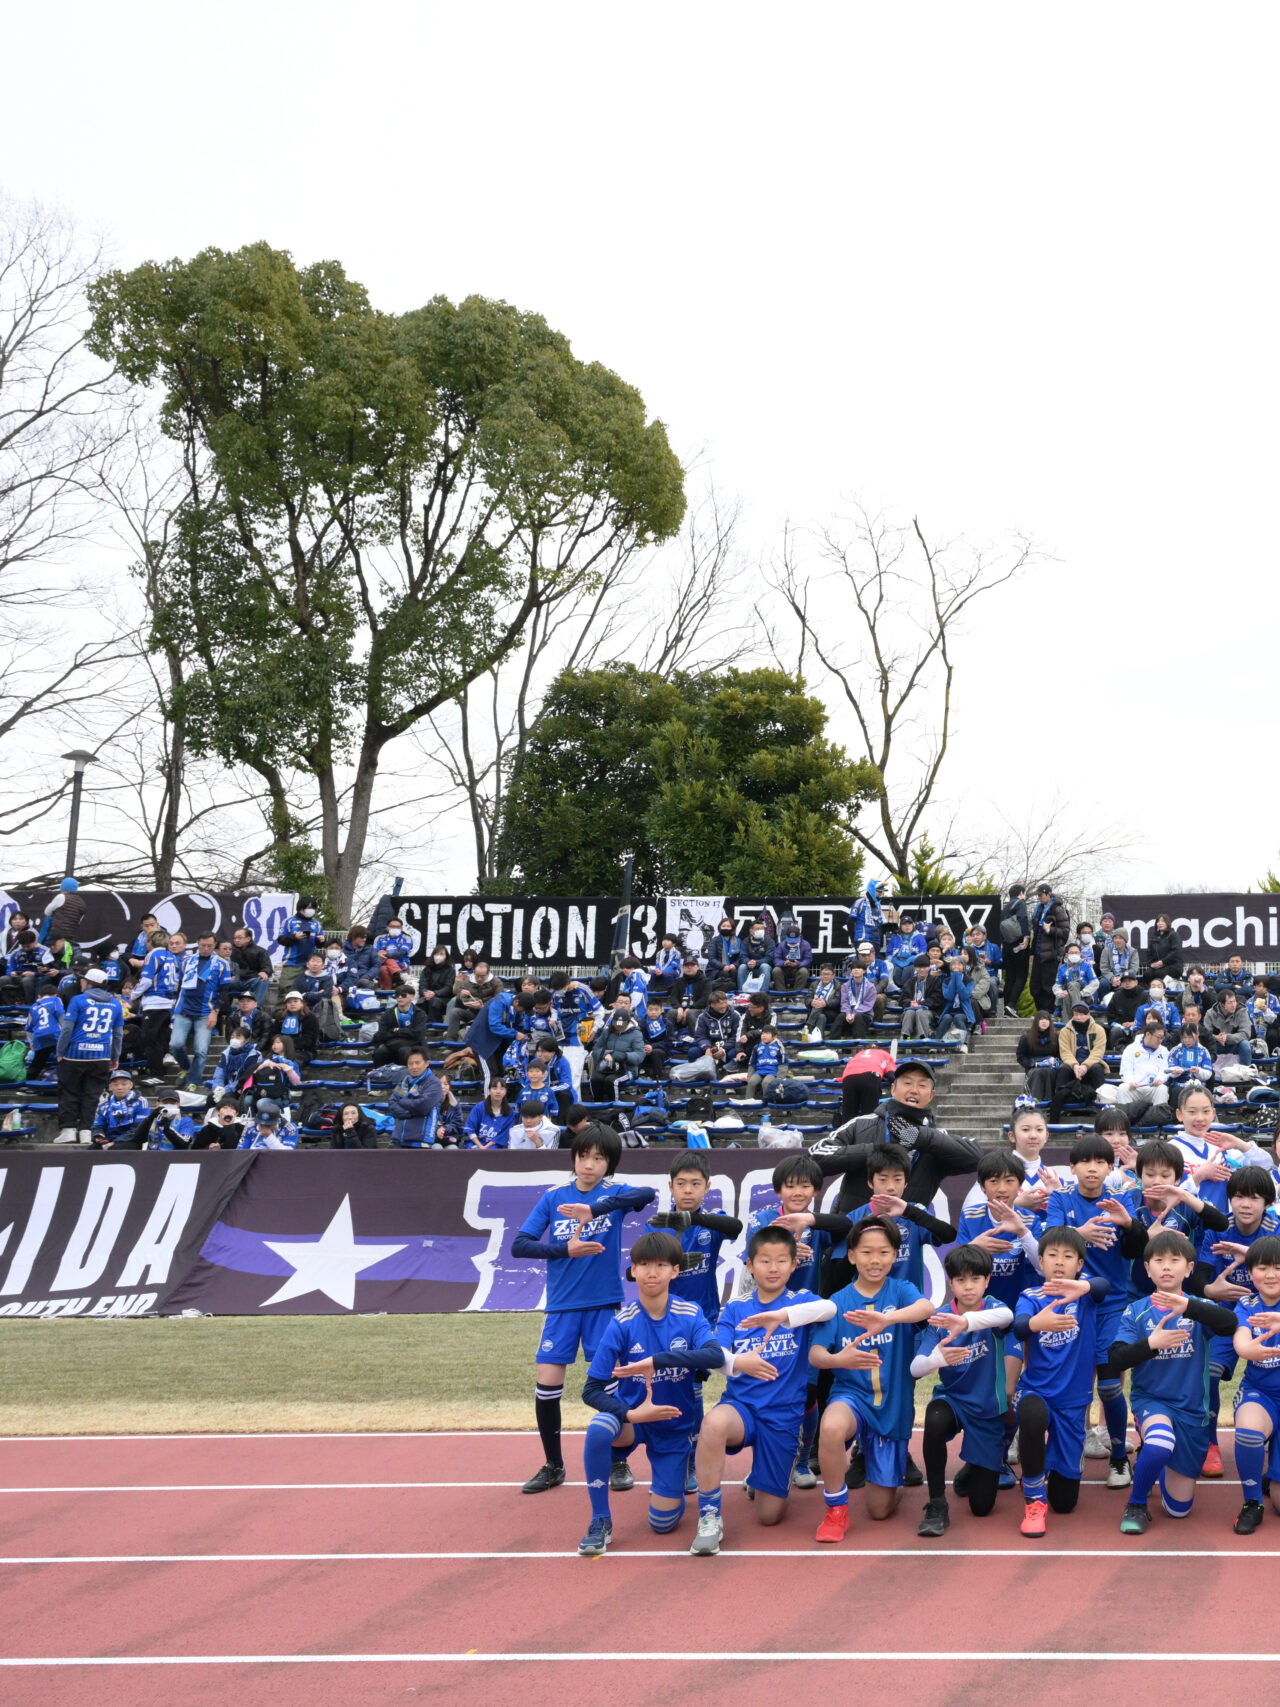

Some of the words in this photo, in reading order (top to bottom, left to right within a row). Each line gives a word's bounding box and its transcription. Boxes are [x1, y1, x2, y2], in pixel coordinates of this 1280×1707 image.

[670, 899, 710, 908] SECTION
[397, 902, 598, 960] SECTION
[82, 1006, 113, 1034] 33
[0, 1163, 201, 1296] IDA
